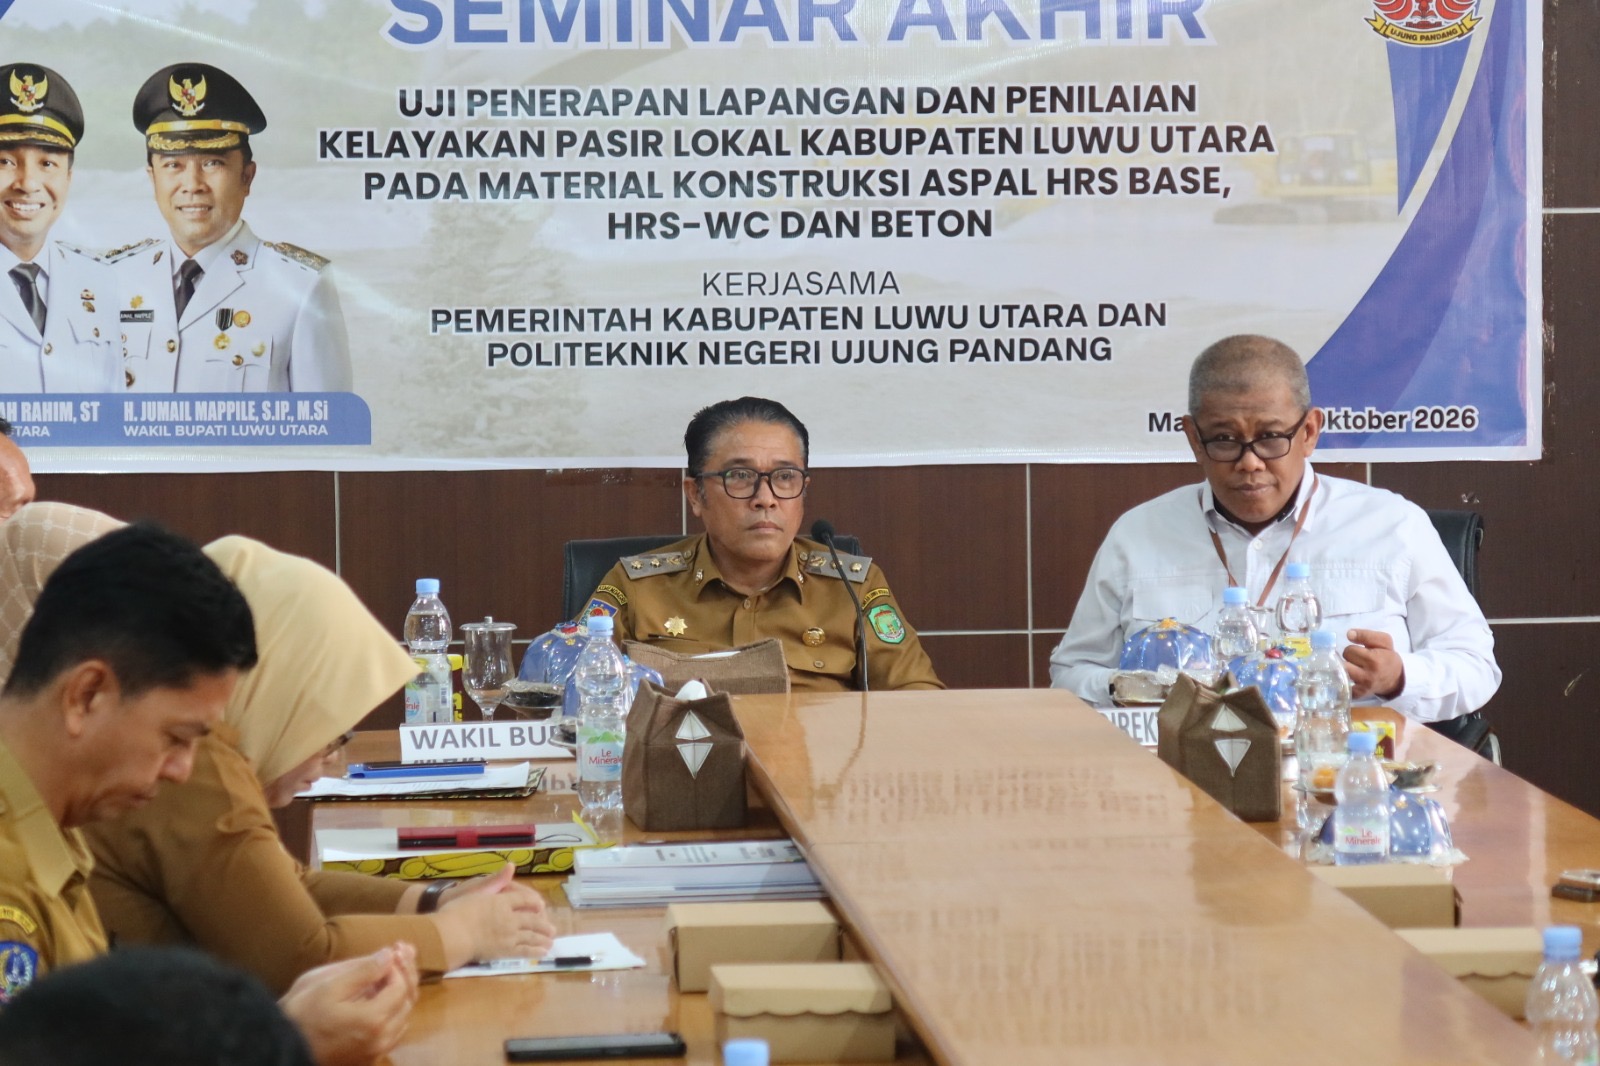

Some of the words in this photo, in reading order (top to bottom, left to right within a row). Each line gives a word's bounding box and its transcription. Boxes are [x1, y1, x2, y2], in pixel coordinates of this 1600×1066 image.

[388, 0, 858, 45] SEMINAR
[886, 0, 1207, 42] AKHIR
[1390, 28, 1418, 41] UJUNG
[1419, 28, 1458, 41] PANDANG
[399, 89, 456, 118] UJI
[467, 88, 688, 117] PENERAPAN
[699, 87, 905, 116] LAPANGAN
[916, 86, 995, 115] DAN
[1006, 84, 1196, 114] PENILAIAN
[319, 130, 545, 159] KELAYAKAN
[556, 129, 664, 158] PASIR
[674, 128, 791, 157] LOKAL
[801, 127, 1023, 156] KABUPATEN
[1034, 126, 1140, 155] LUWU
[1150, 125, 1275, 154] UTARA
[364, 172, 469, 200] PADA
[479, 171, 664, 200] MATERIAL
[673, 168, 910, 199] KONSTRUKSI
[919, 168, 1038, 197] ASPAL
[1047, 167, 1119, 196] HRS
[1129, 166, 1231, 199] BASE,
[608, 211, 770, 240] HRS-WC
[780, 210, 860, 239] DAN
[871, 209, 992, 238] BETON
[703, 270, 900, 297] KERJASAMA
[431, 307, 652, 333] PEMERINTAH
[663, 306, 862, 332] KABUPATEN
[874, 304, 969, 330] LUWU
[979, 303, 1088, 329] UTARA
[1098, 302, 1166, 327] DAN
[488, 341, 689, 367] POLITEKNIK
[698, 340, 821, 366] NEGERI
[831, 338, 939, 365] UJUNG
[949, 336, 1112, 363] PANDANG
[21, 401, 77, 424] RAHIM,
[80, 401, 100, 422] ST
[124, 401, 138, 422] H.
[140, 401, 192, 422] JUMAIL
[195, 401, 260, 423] MAPPILE,
[297, 400, 328, 421] M.Si
[1321, 409, 1408, 431] ktober
[1414, 408, 1476, 429] 2026
[8, 425, 50, 437] TARA
[124, 425, 172, 437] WAKIL
[175, 425, 228, 437] BUPATI
[232, 425, 276, 436] LUWU
[279, 424, 328, 436] UTARA
[410, 726, 501, 749] WAKIL
[601, 748, 612, 757] Le
